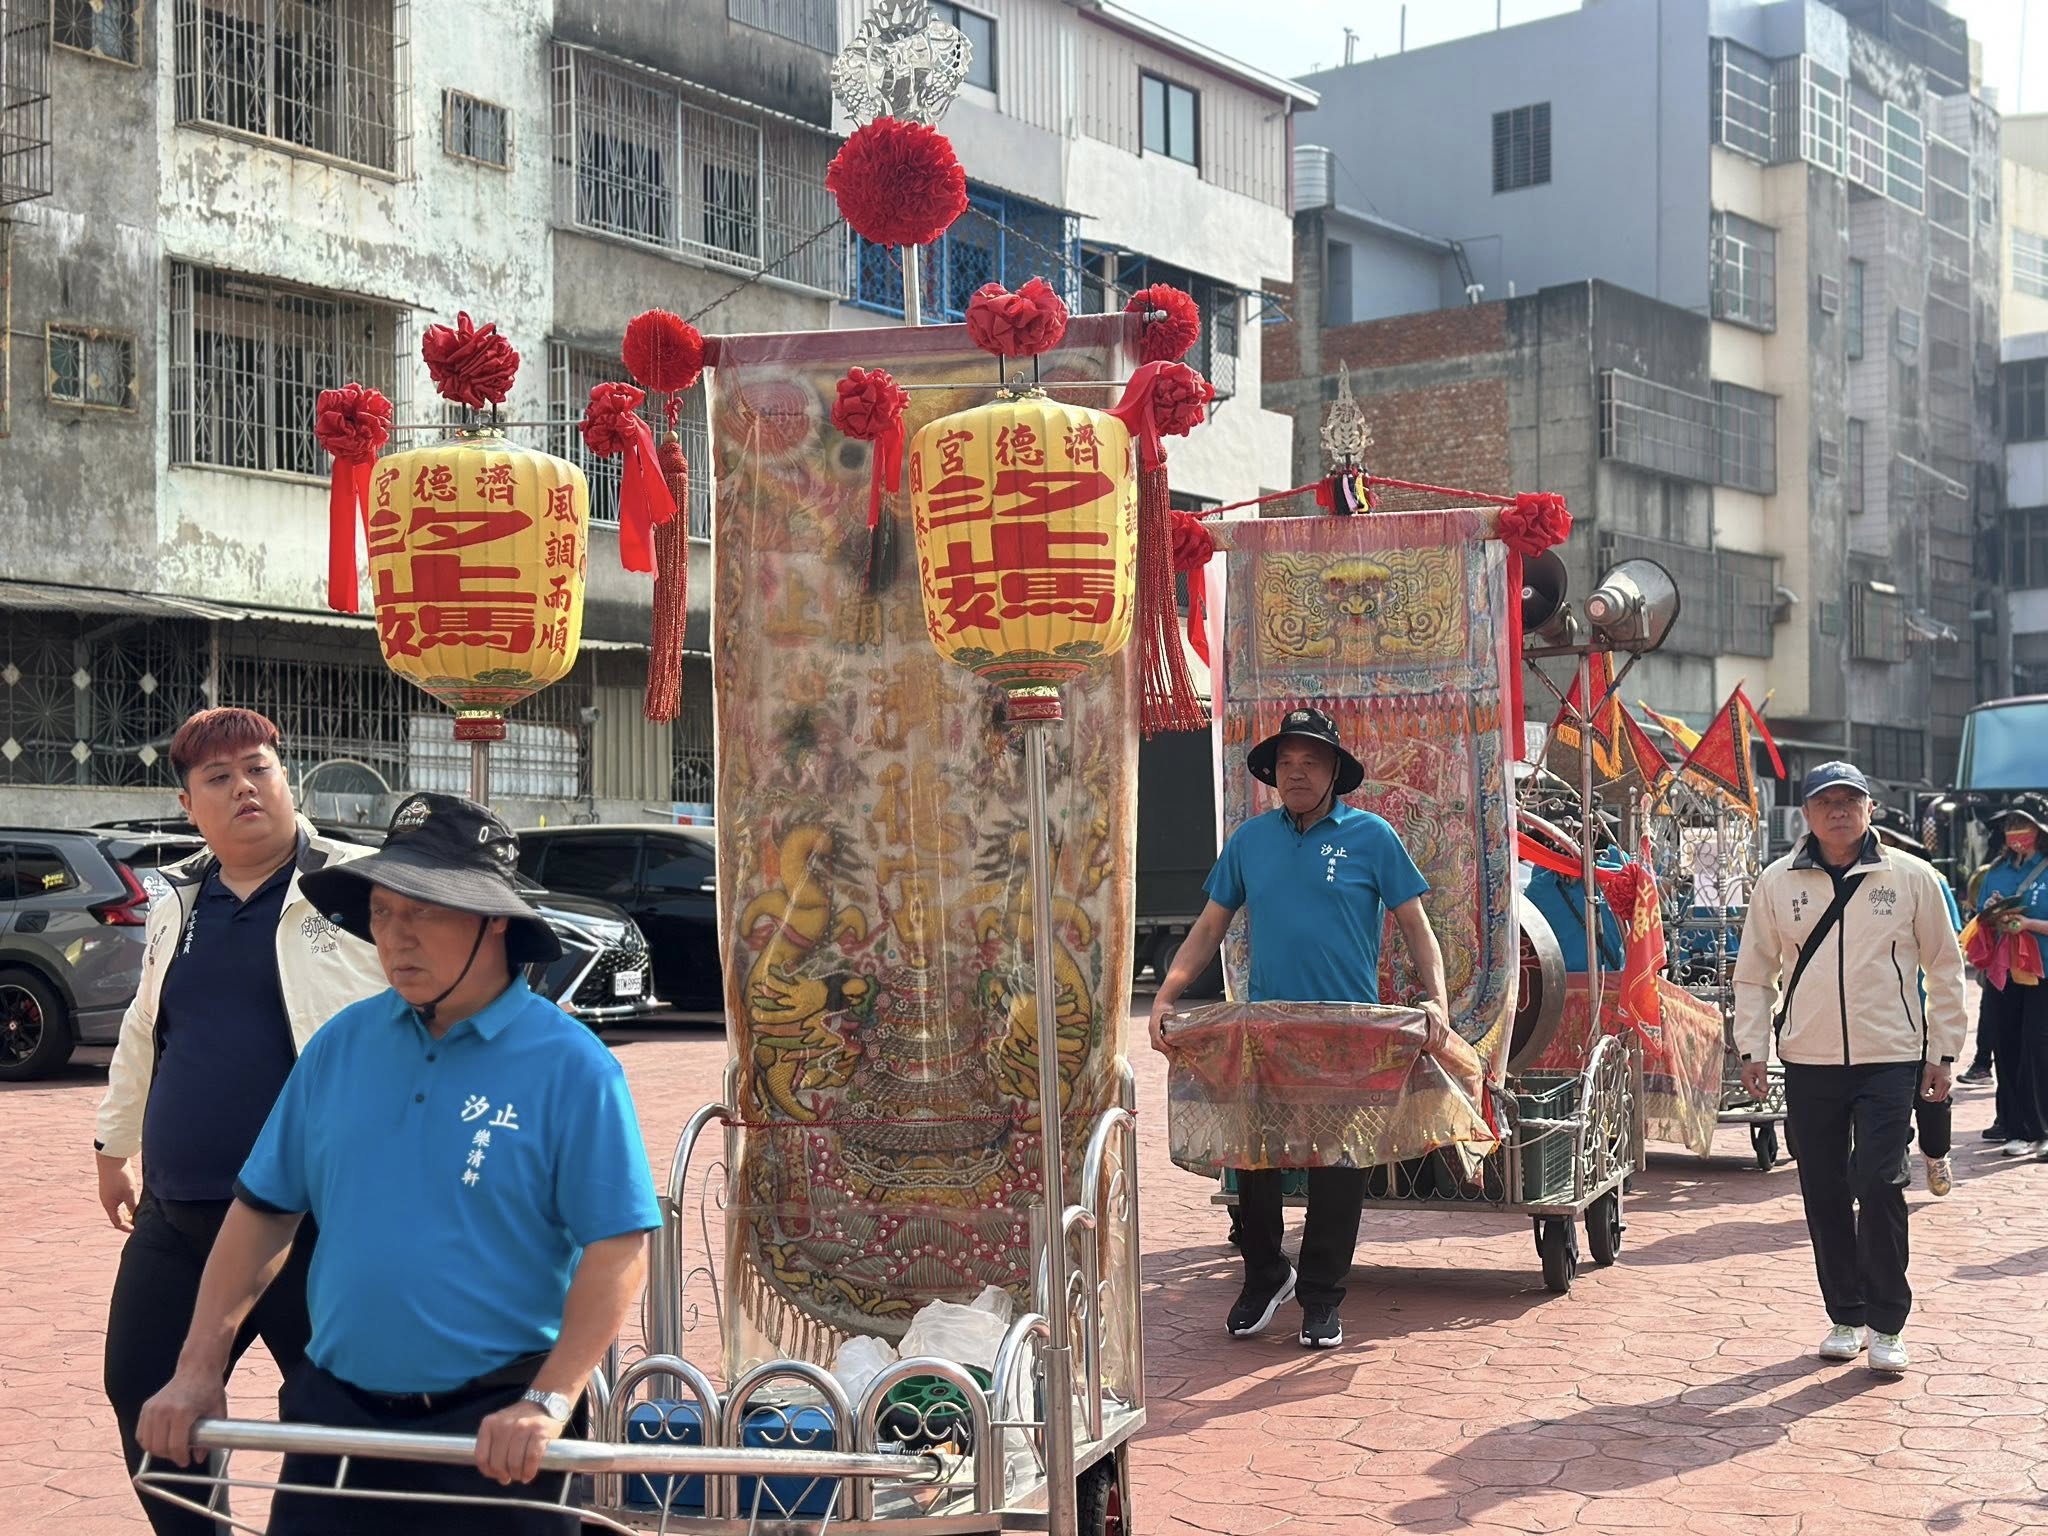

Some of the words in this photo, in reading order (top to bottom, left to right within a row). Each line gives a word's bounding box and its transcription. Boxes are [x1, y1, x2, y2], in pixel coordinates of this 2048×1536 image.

[369, 506, 538, 660] 汐止媽
[536, 484, 579, 655] 風調雨順
[928, 469, 1117, 634] 汐止媽
[1320, 843, 1348, 858] 汐止
[461, 1094, 520, 1130] 汐止
